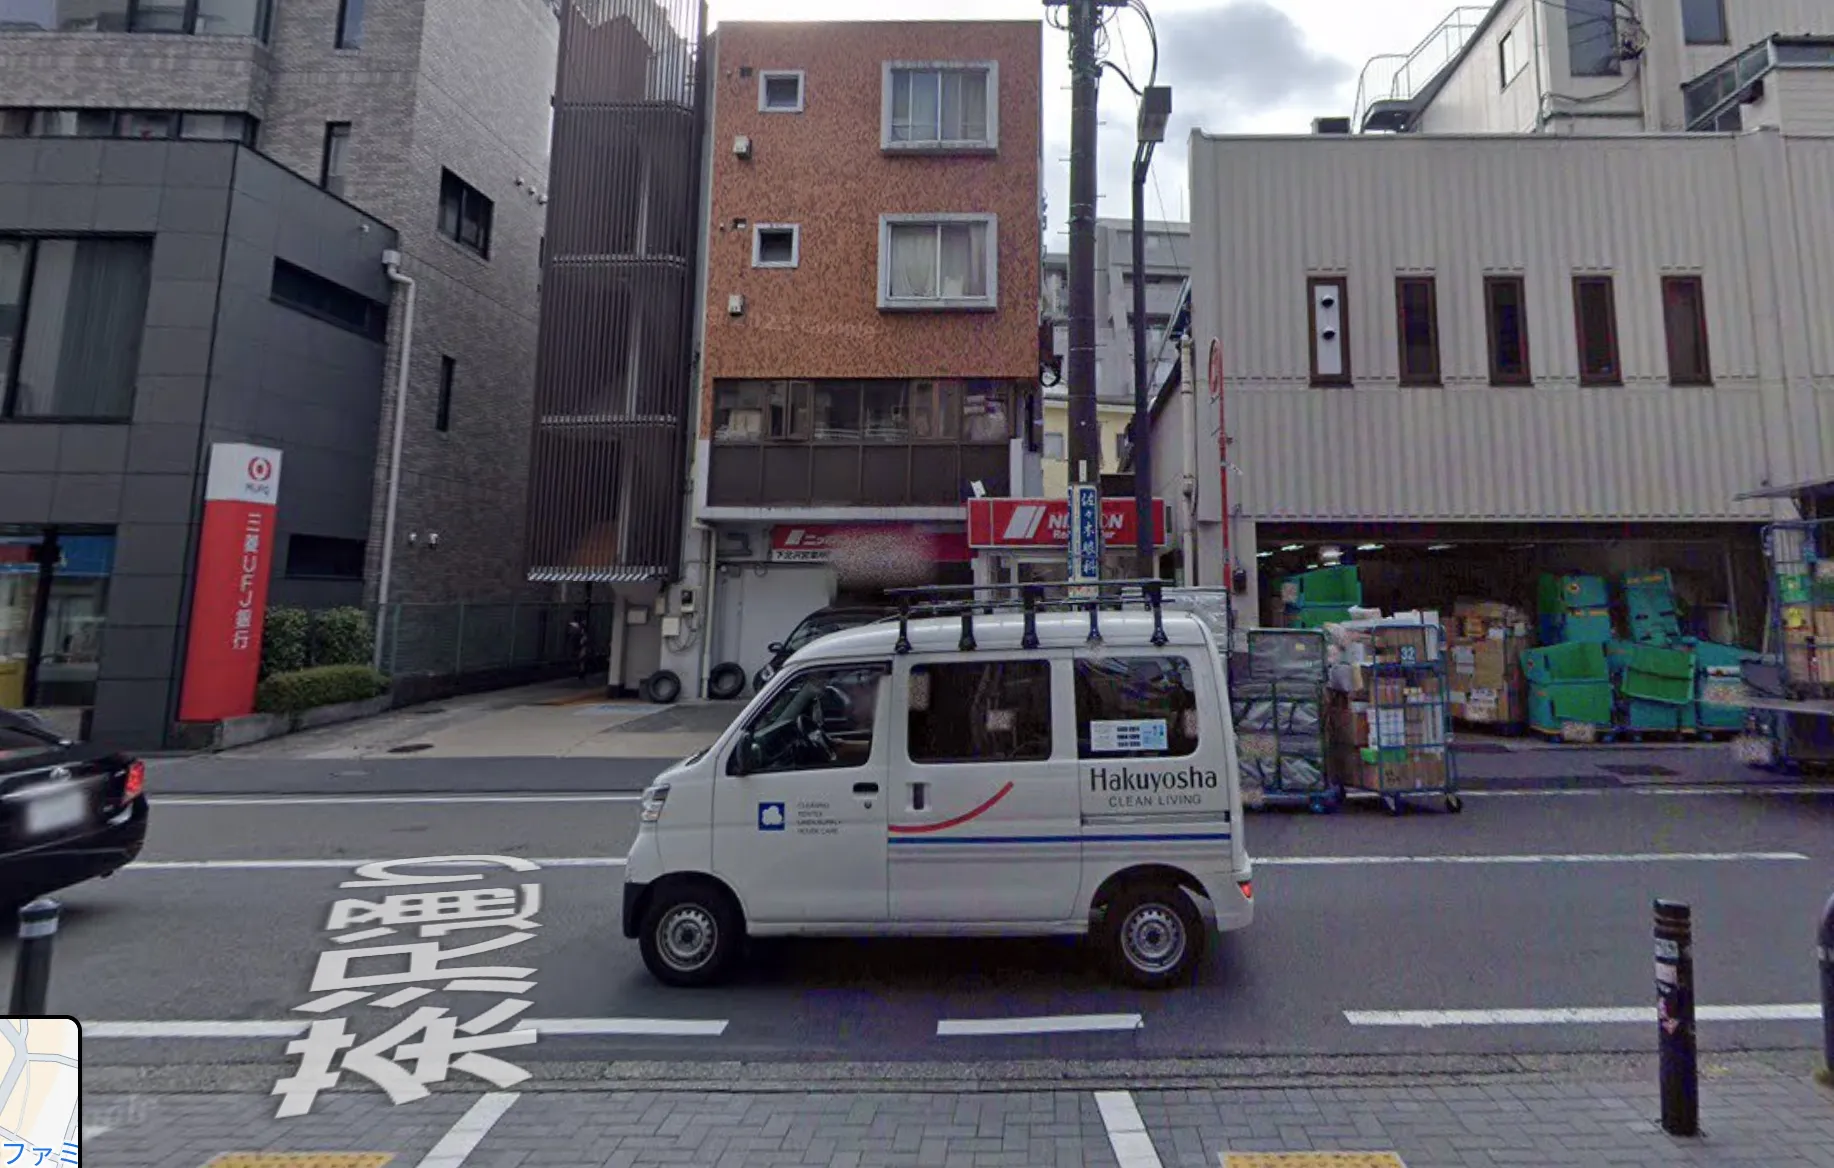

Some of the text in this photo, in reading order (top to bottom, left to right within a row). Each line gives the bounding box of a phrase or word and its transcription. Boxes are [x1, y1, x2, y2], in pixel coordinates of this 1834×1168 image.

[1081, 493, 1096, 574] 佐々木眼科
[1400, 646, 1415, 660] 32
[1090, 766, 1217, 792] Hakuyosha
[1109, 794, 1202, 808] CLEAN LIVING
[272, 854, 543, 1120] 茶沢通り
